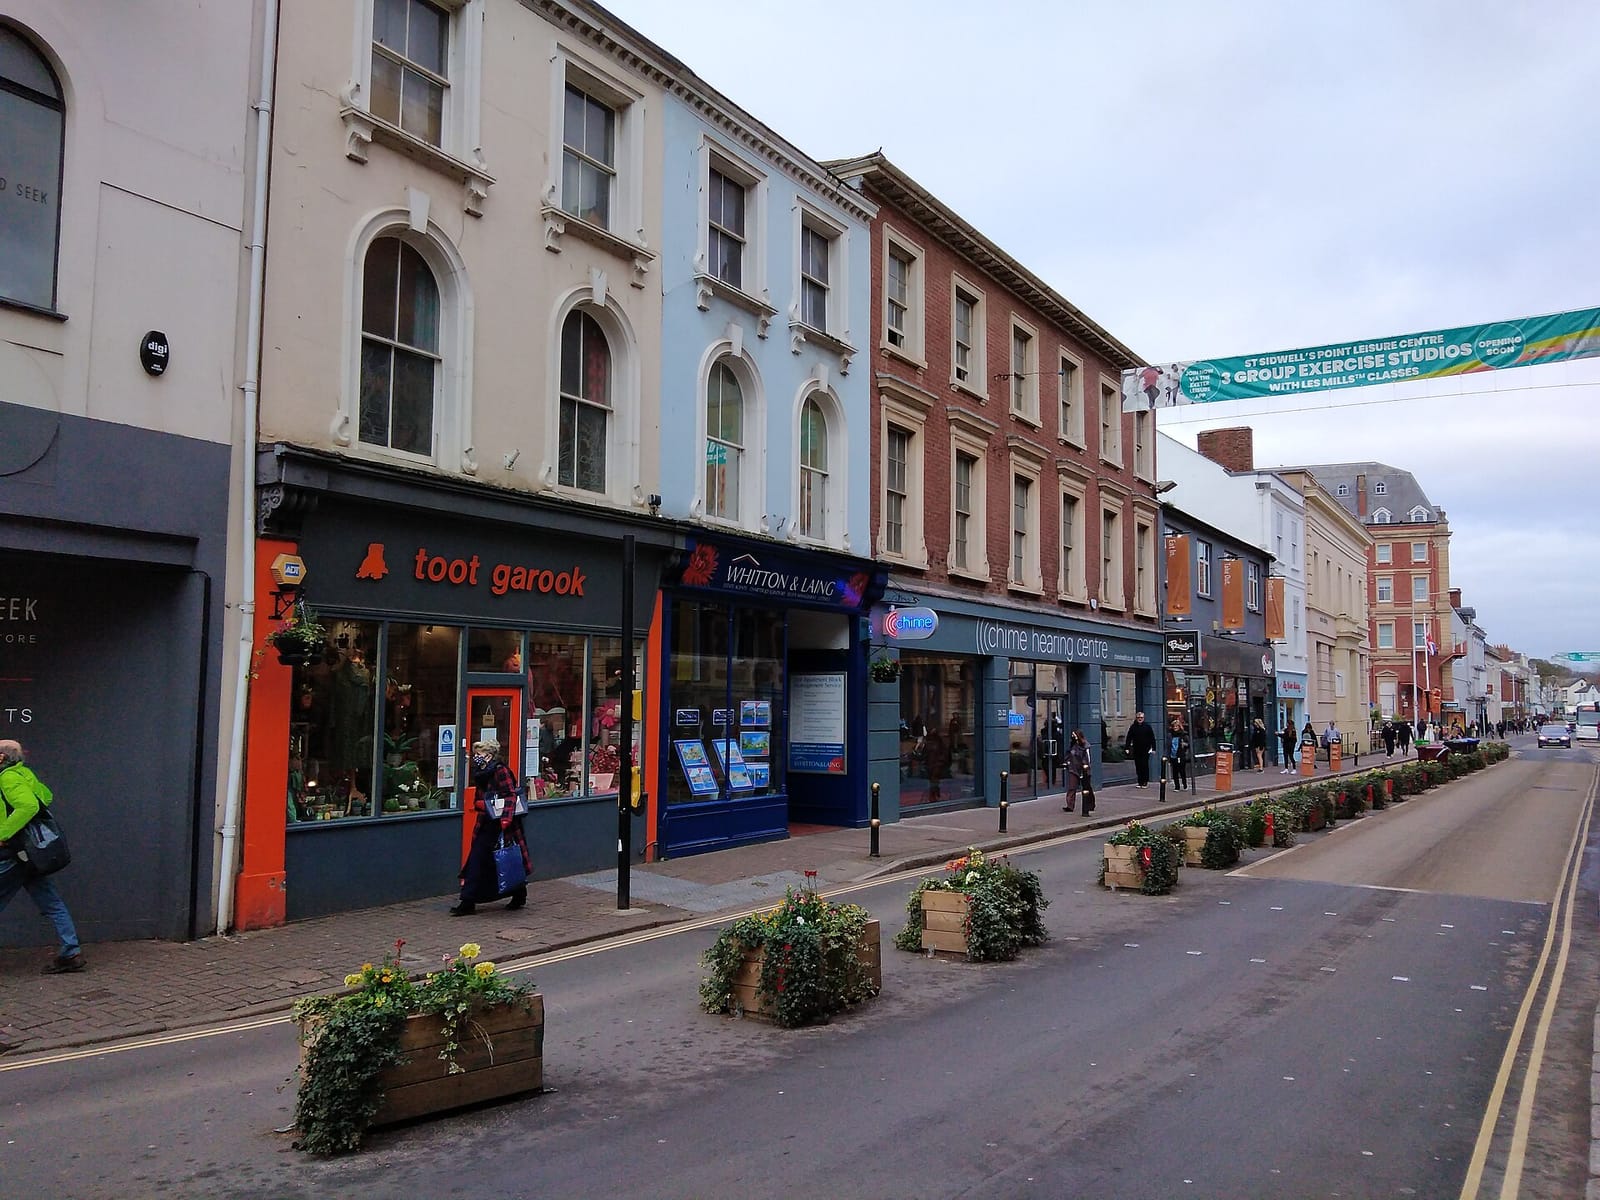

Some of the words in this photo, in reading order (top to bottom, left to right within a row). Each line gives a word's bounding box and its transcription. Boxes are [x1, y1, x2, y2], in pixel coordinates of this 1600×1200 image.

[16, 184, 48, 205] SEEK
[148, 341, 167, 354] digi
[1244, 358, 1258, 368] ST
[1259, 351, 1316, 366] SIDWELL'S
[1317, 346, 1352, 359] POINT
[1353, 341, 1398, 354] LEISURE
[1399, 334, 1444, 348] CENTRE
[1478, 336, 1522, 348] OPENING
[1486, 346, 1515, 356] SOON
[1221, 371, 1231, 385] 3
[1234, 365, 1296, 383] GROUP
[1299, 353, 1385, 377] EXERCISE
[1388, 342, 1473, 366] STUDIOS
[1269, 381, 1300, 392] WITH
[1301, 379, 1321, 389] LES
[1367, 367, 1420, 381] CLASSES
[415, 548, 481, 585] toot
[491, 563, 587, 597] garook
[727, 565, 789, 590] WHITTON
[789, 576, 799, 591] &
[801, 577, 836, 596] LAING
[896, 616, 933, 630] chime
[0, 634, 37, 643] ORE
[988, 623, 1027, 651] chime
[1032, 627, 1074, 662] hearing
[1076, 635, 1108, 660] centre
[4, 708, 33, 723] TS
